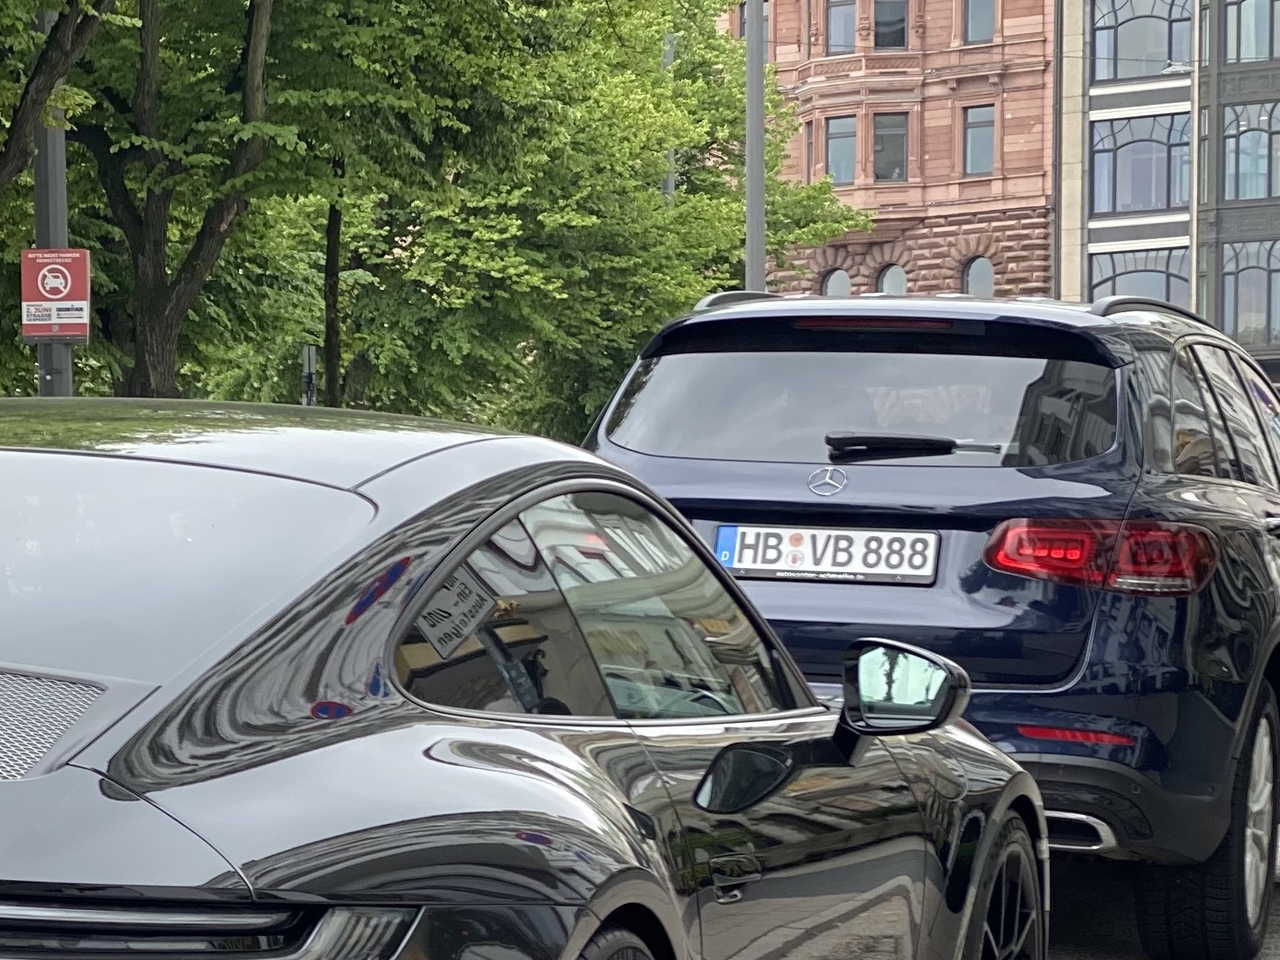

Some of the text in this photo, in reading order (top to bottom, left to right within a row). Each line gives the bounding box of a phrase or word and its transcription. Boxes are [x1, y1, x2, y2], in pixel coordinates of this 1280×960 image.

[721, 550, 730, 562] D
[737, 532, 929, 570] HB VB 888
